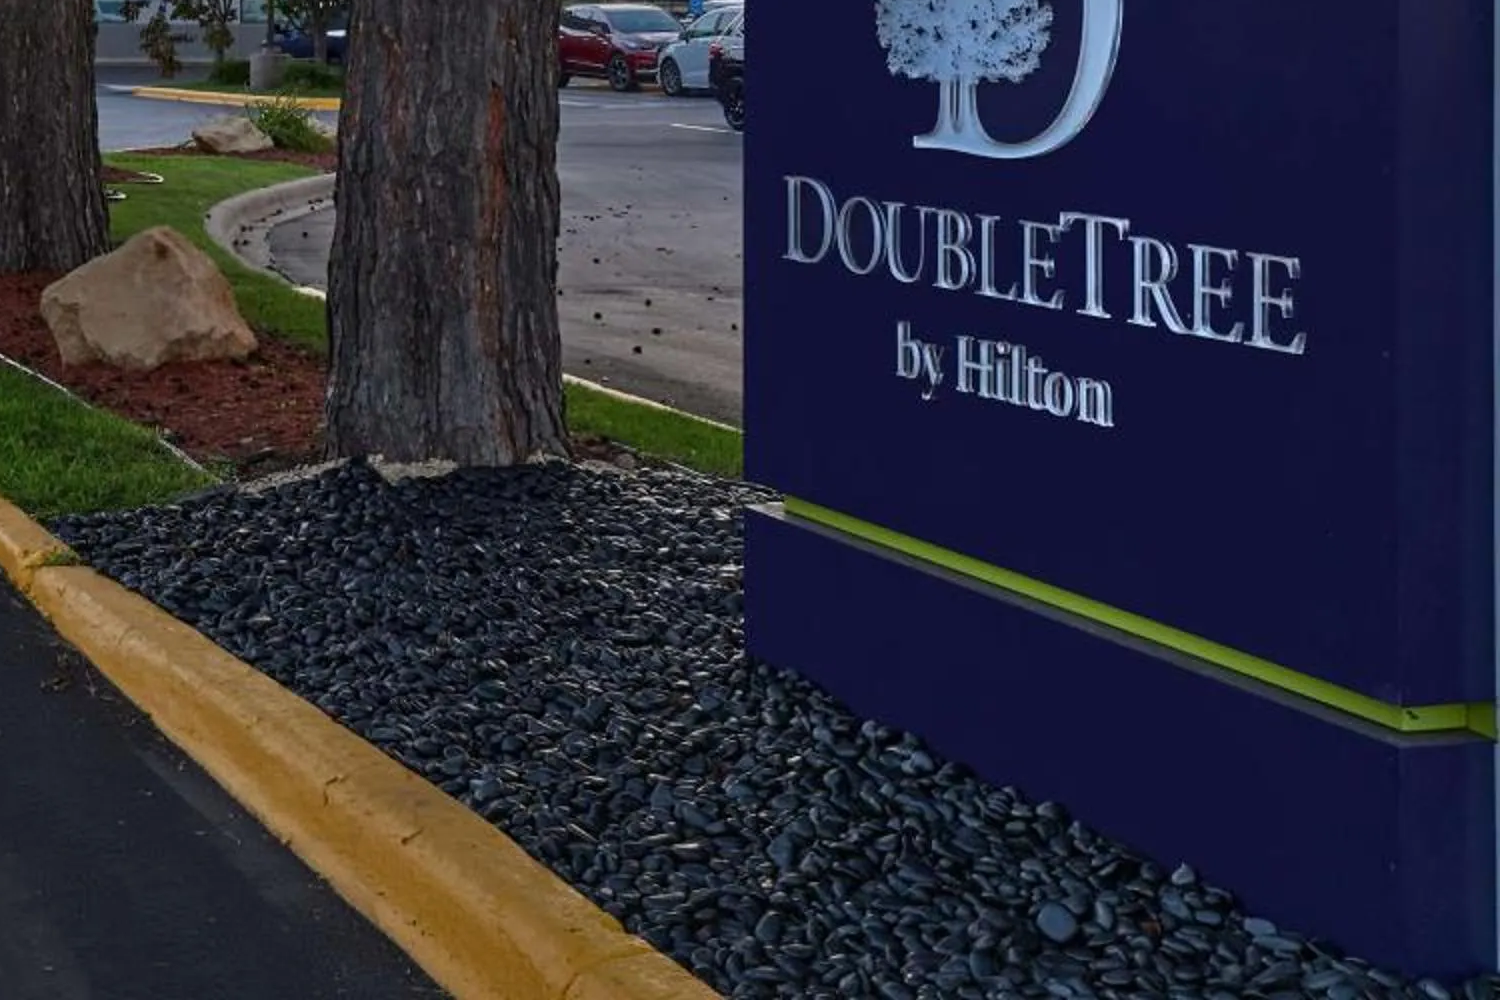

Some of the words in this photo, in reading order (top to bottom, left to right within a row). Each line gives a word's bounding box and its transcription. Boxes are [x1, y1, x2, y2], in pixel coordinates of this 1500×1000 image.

[781, 174, 1308, 356] DOUBLETREE
[895, 320, 946, 400] by
[955, 334, 1115, 428] Hilton
